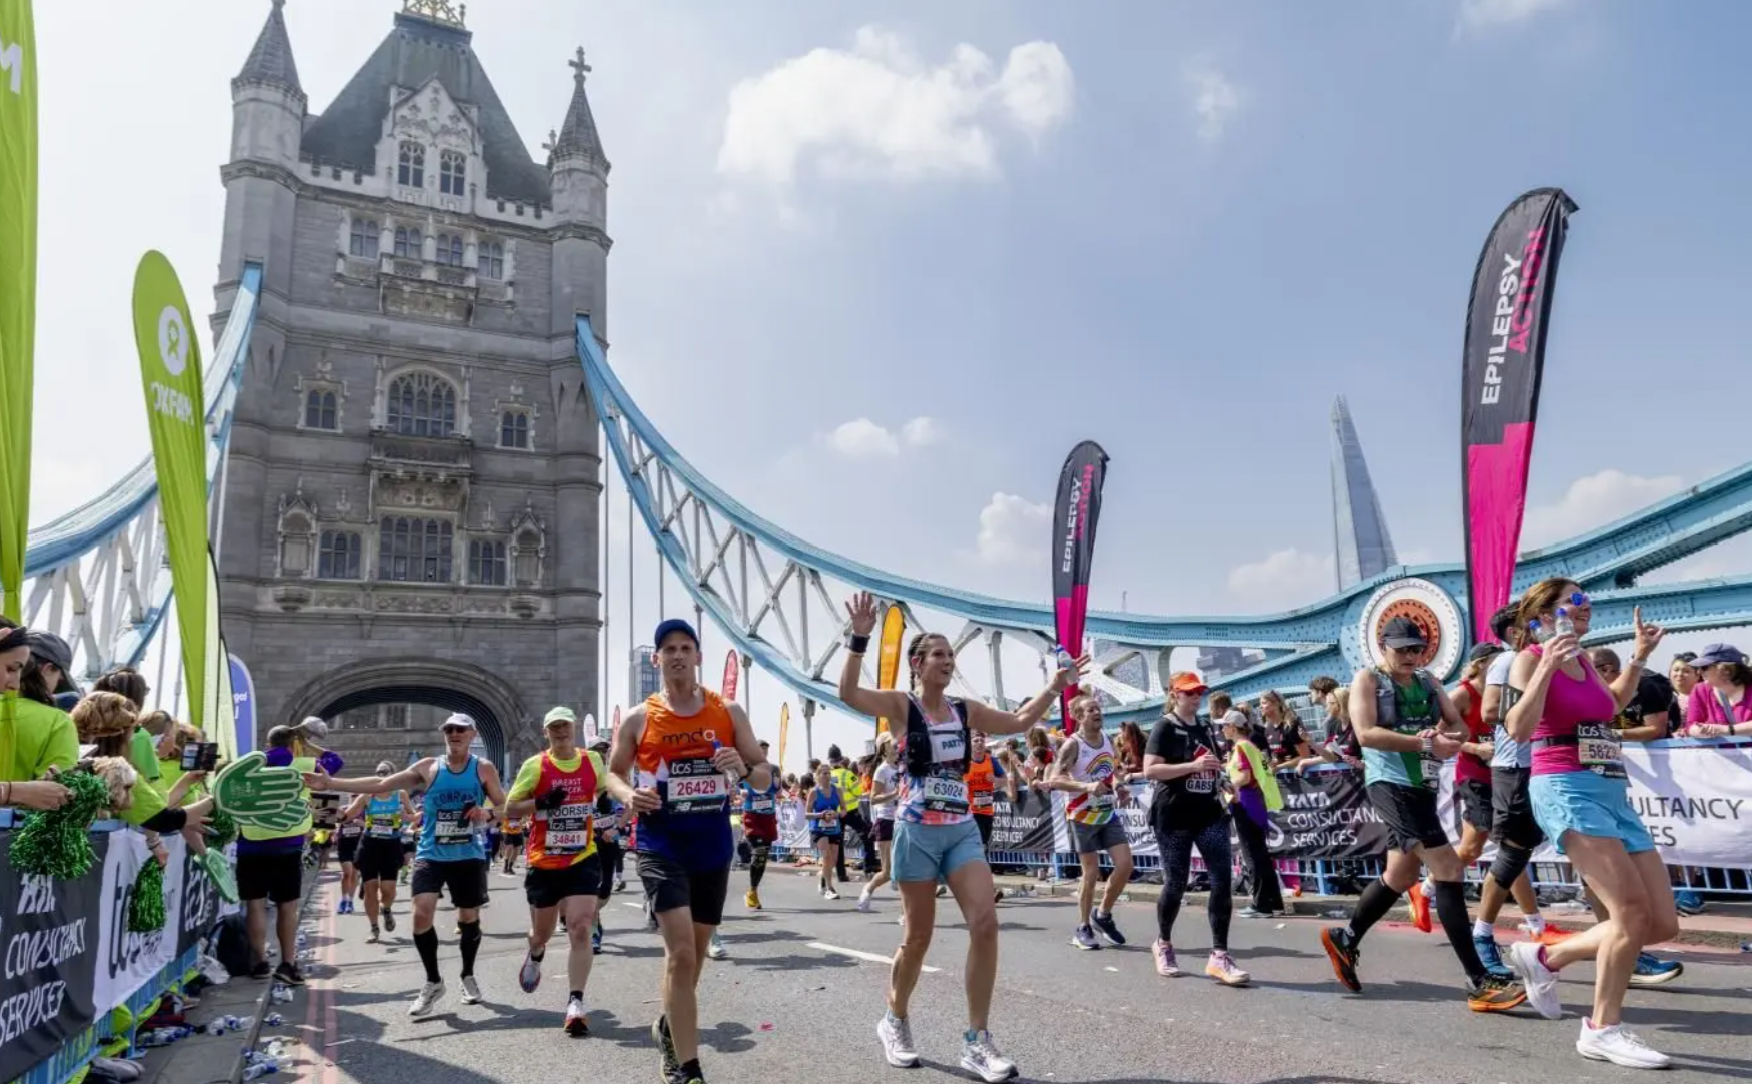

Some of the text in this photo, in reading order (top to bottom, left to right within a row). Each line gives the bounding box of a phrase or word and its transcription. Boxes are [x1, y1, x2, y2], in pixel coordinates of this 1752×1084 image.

[1508, 225, 1548, 354] ACTION
[1481, 252, 1521, 405] EPILEPSY
[1062, 476, 1082, 574] EPILEPSY
[677, 780, 716, 797] 26429
[1287, 791, 1331, 809] TATA
[1627, 796, 1745, 820] ULTANCY
[1291, 829, 1358, 848] SERVICES
